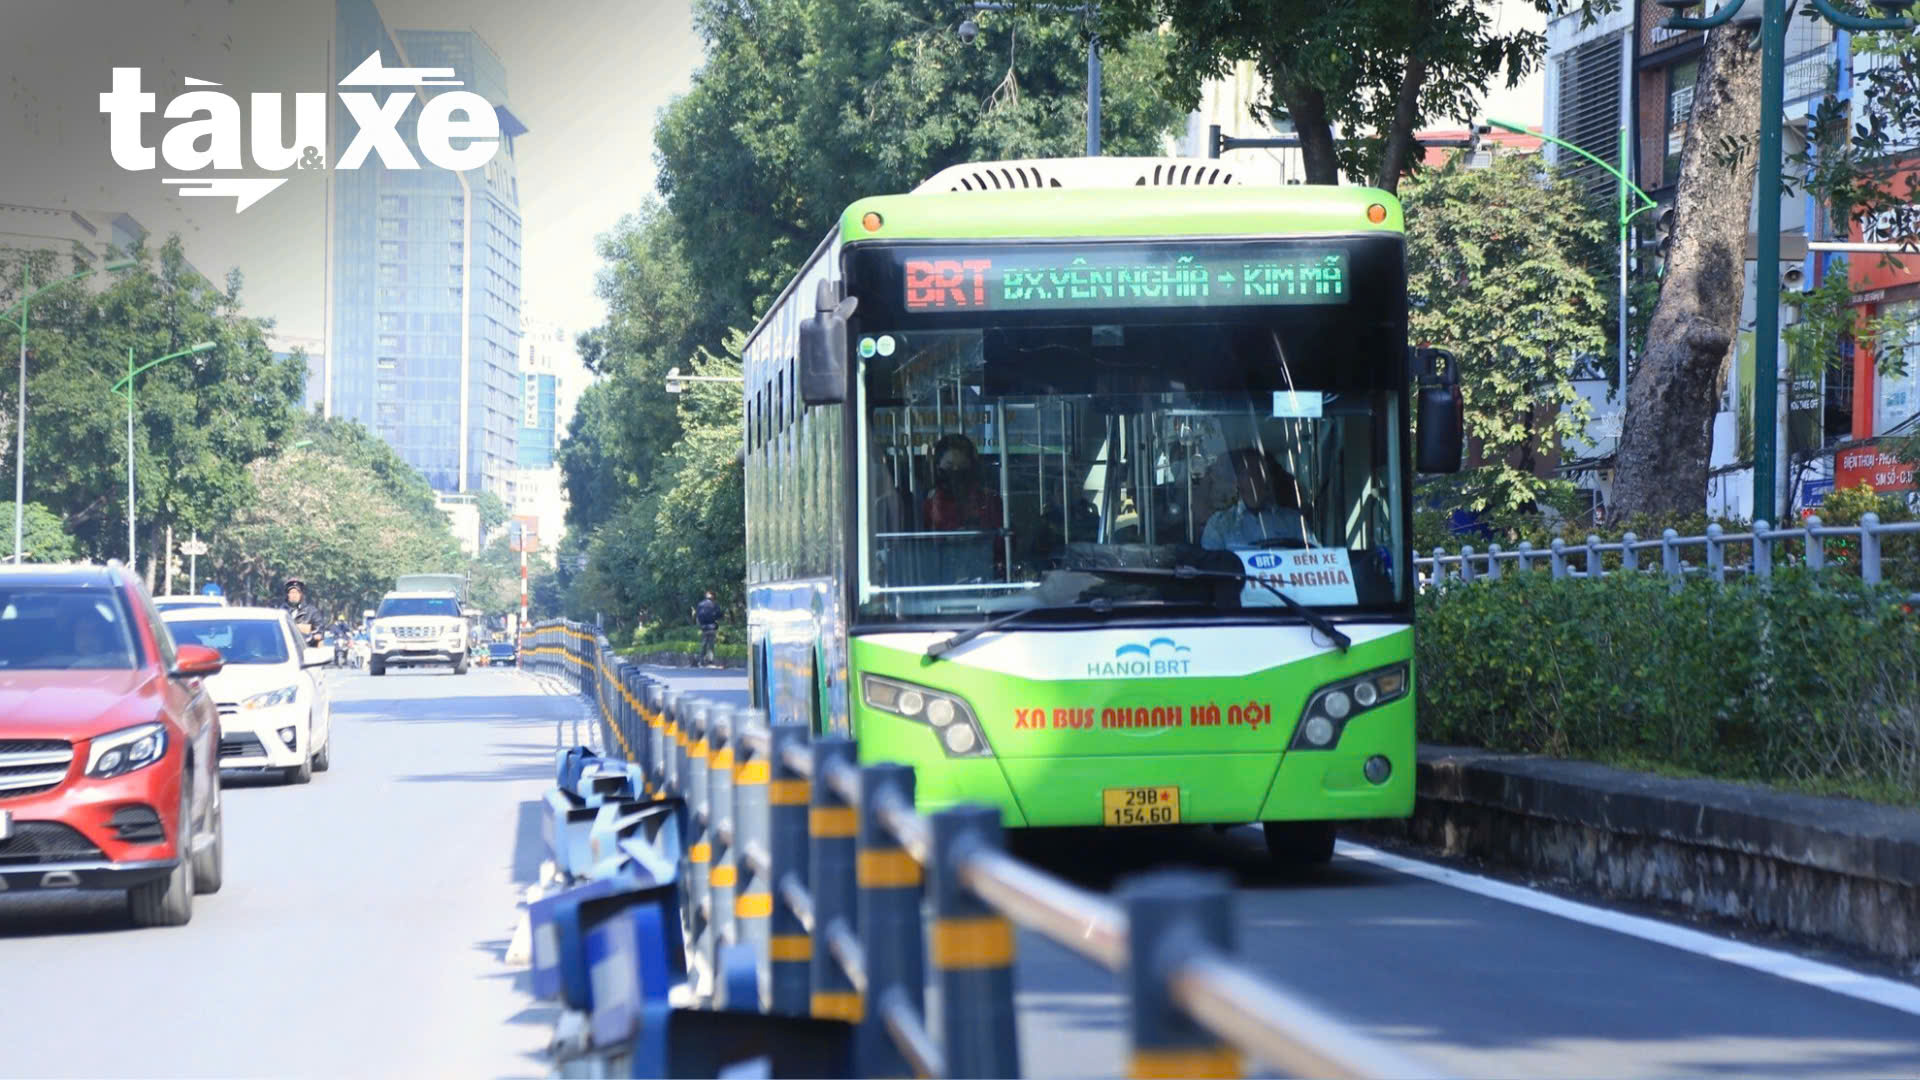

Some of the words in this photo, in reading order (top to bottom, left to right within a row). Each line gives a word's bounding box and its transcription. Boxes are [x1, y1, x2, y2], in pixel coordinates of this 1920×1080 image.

[906, 259, 991, 307] BRT
[1244, 264, 1295, 296] KIM
[1255, 554, 1276, 567] BRT
[1322, 553, 1337, 564] XE
[1052, 707, 1095, 728] BUS
[1101, 706, 1183, 729] NHANH
[1190, 702, 1221, 726] HÀ
[1227, 700, 1272, 730] NỘI
[1126, 789, 1158, 806] 29B
[1114, 807, 1172, 825] 154.60
